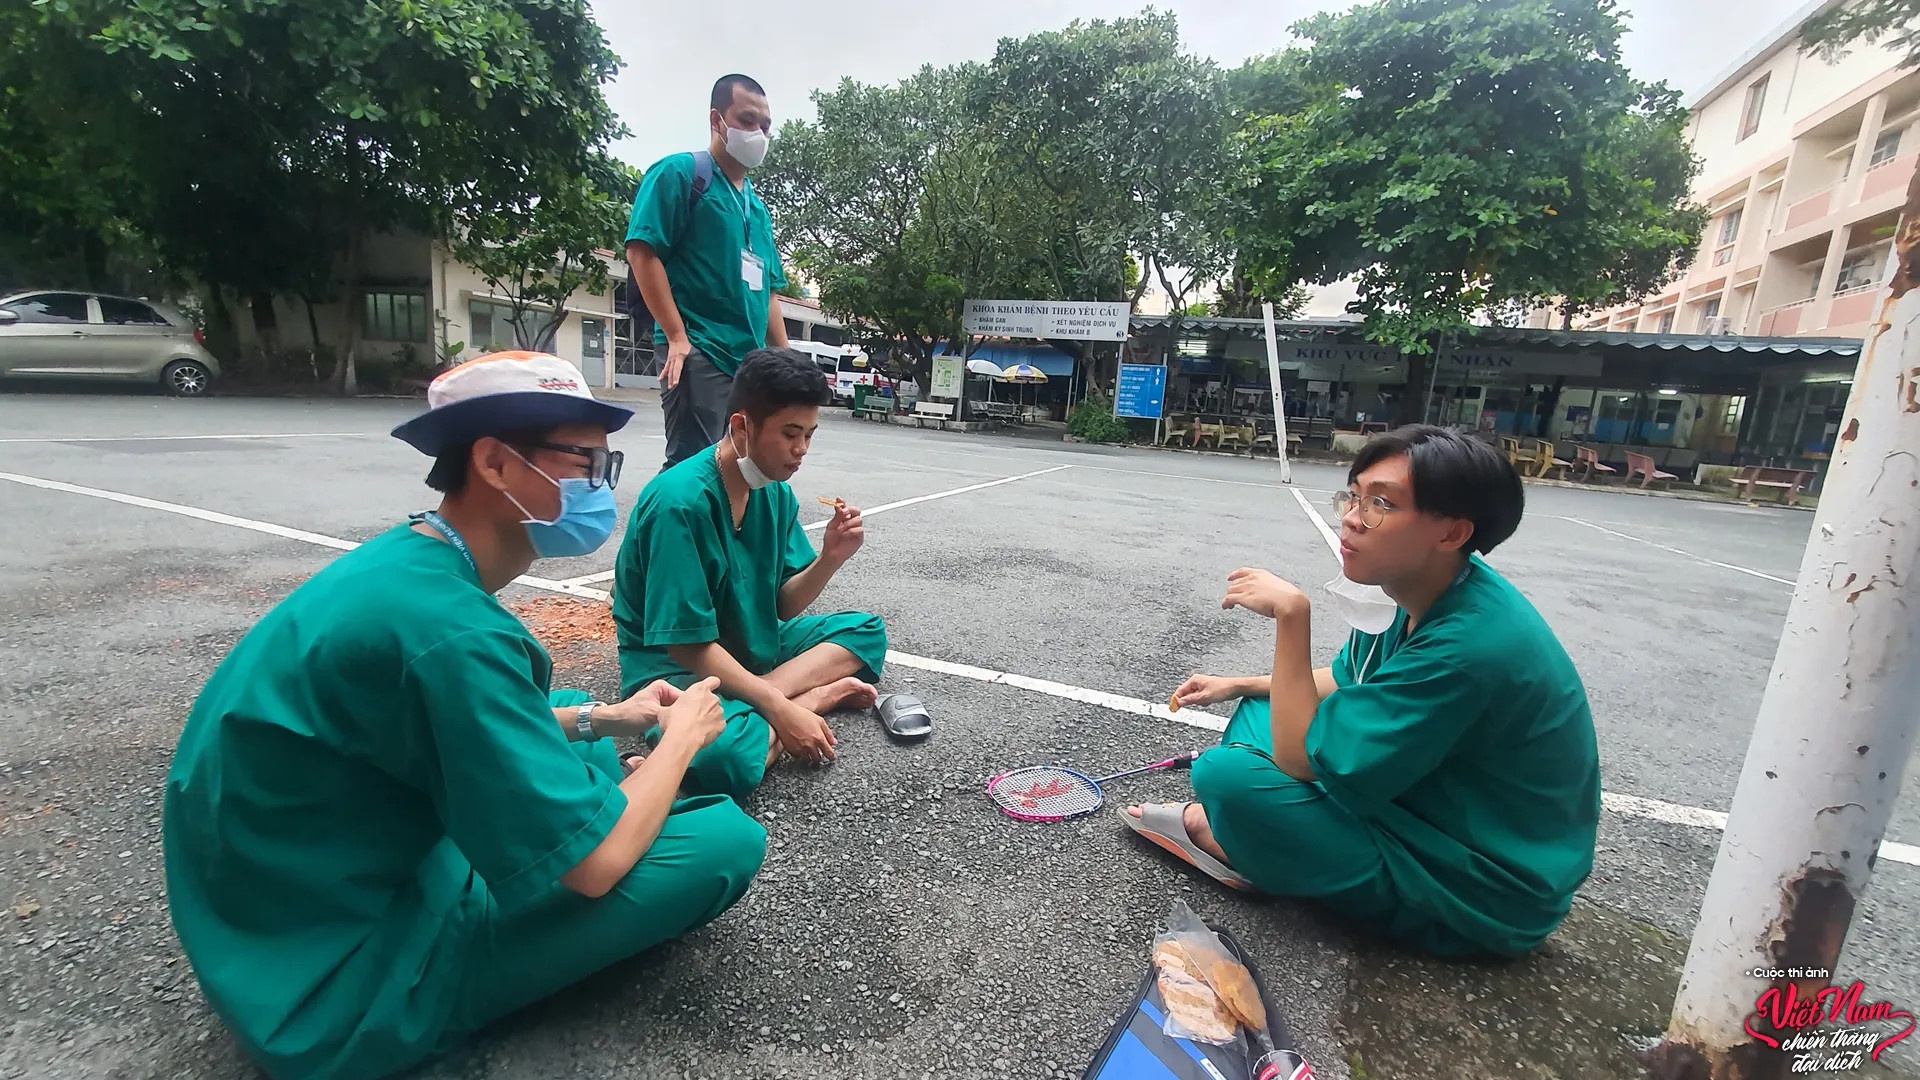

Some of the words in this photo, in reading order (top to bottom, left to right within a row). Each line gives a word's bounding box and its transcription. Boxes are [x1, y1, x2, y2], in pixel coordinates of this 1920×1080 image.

[972, 304, 995, 313] KHOA
[997, 303, 1023, 314] KHÁM
[1025, 304, 1049, 316] BỆNH
[1052, 306, 1076, 315] THEO
[1078, 305, 1097, 316] YÊU
[1069, 319, 1091, 327] NGHIỆM
[1296, 348, 1338, 359] KHU
